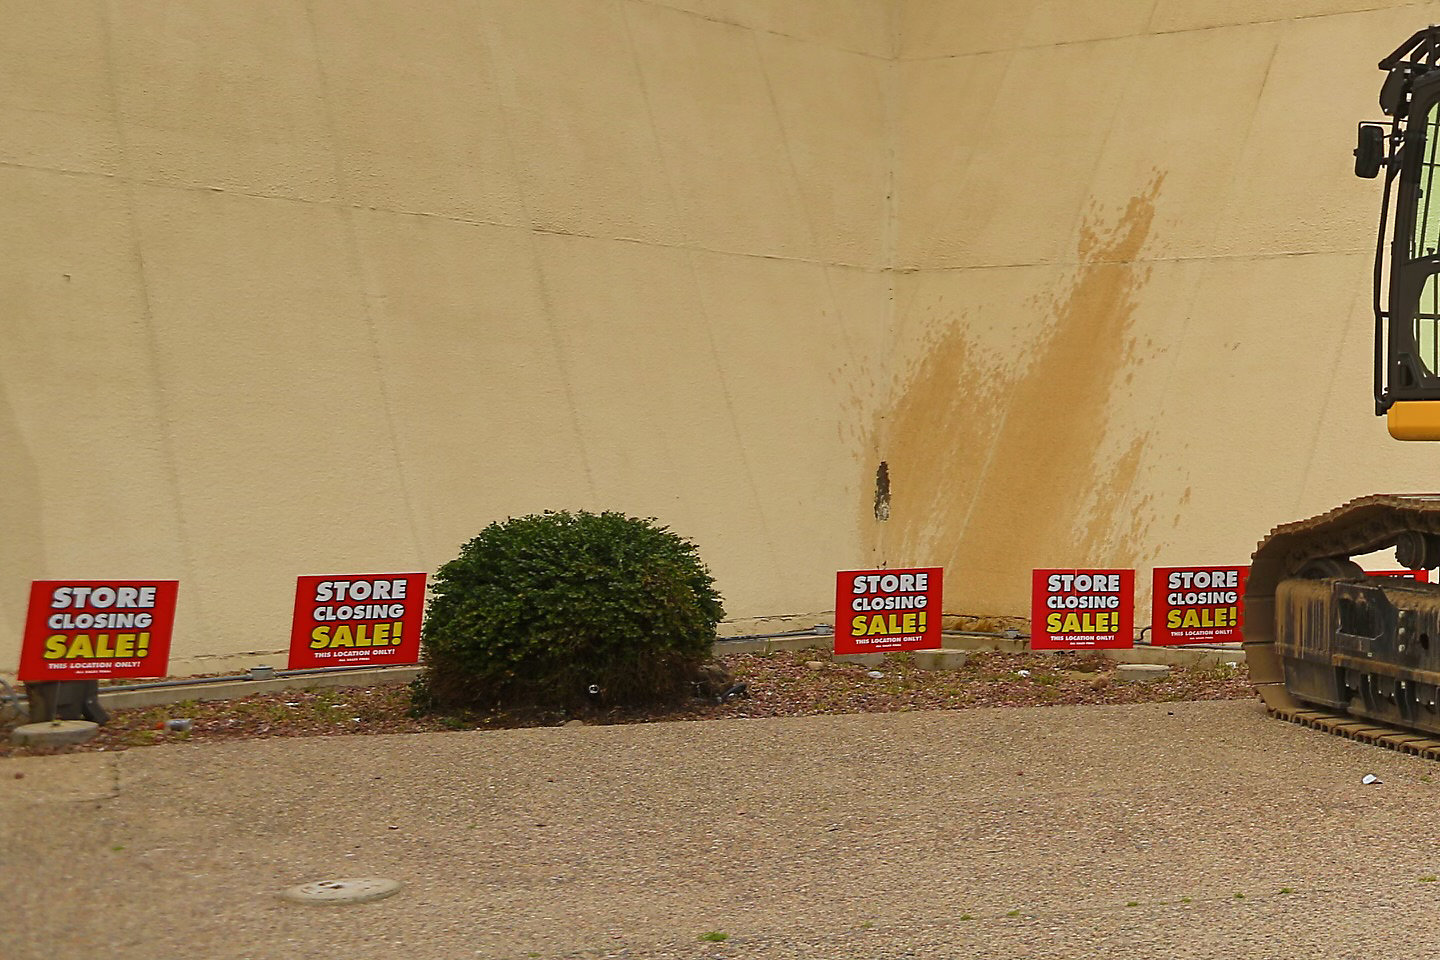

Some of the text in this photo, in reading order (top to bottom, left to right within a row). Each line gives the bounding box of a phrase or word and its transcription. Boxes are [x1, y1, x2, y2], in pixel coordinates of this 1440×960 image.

[853, 574, 928, 594] STORE
[1047, 574, 1120, 592] STORE
[1168, 571, 1238, 589] STORE
[51, 586, 157, 608] STORE
[315, 580, 407, 601] STORE
[1167, 592, 1237, 605] CLOSING
[313, 604, 404, 620] CLOSING
[852, 596, 927, 611] CLOSING
[1047, 596, 1119, 609] CLOSING
[48, 613, 152, 629] CLOSING
[851, 611, 927, 636] SALE!
[1046, 612, 1119, 633] SALE!
[1167, 607, 1237, 628] SALE!
[44, 632, 150, 659] SALE!
[310, 622, 403, 649] SALE!
